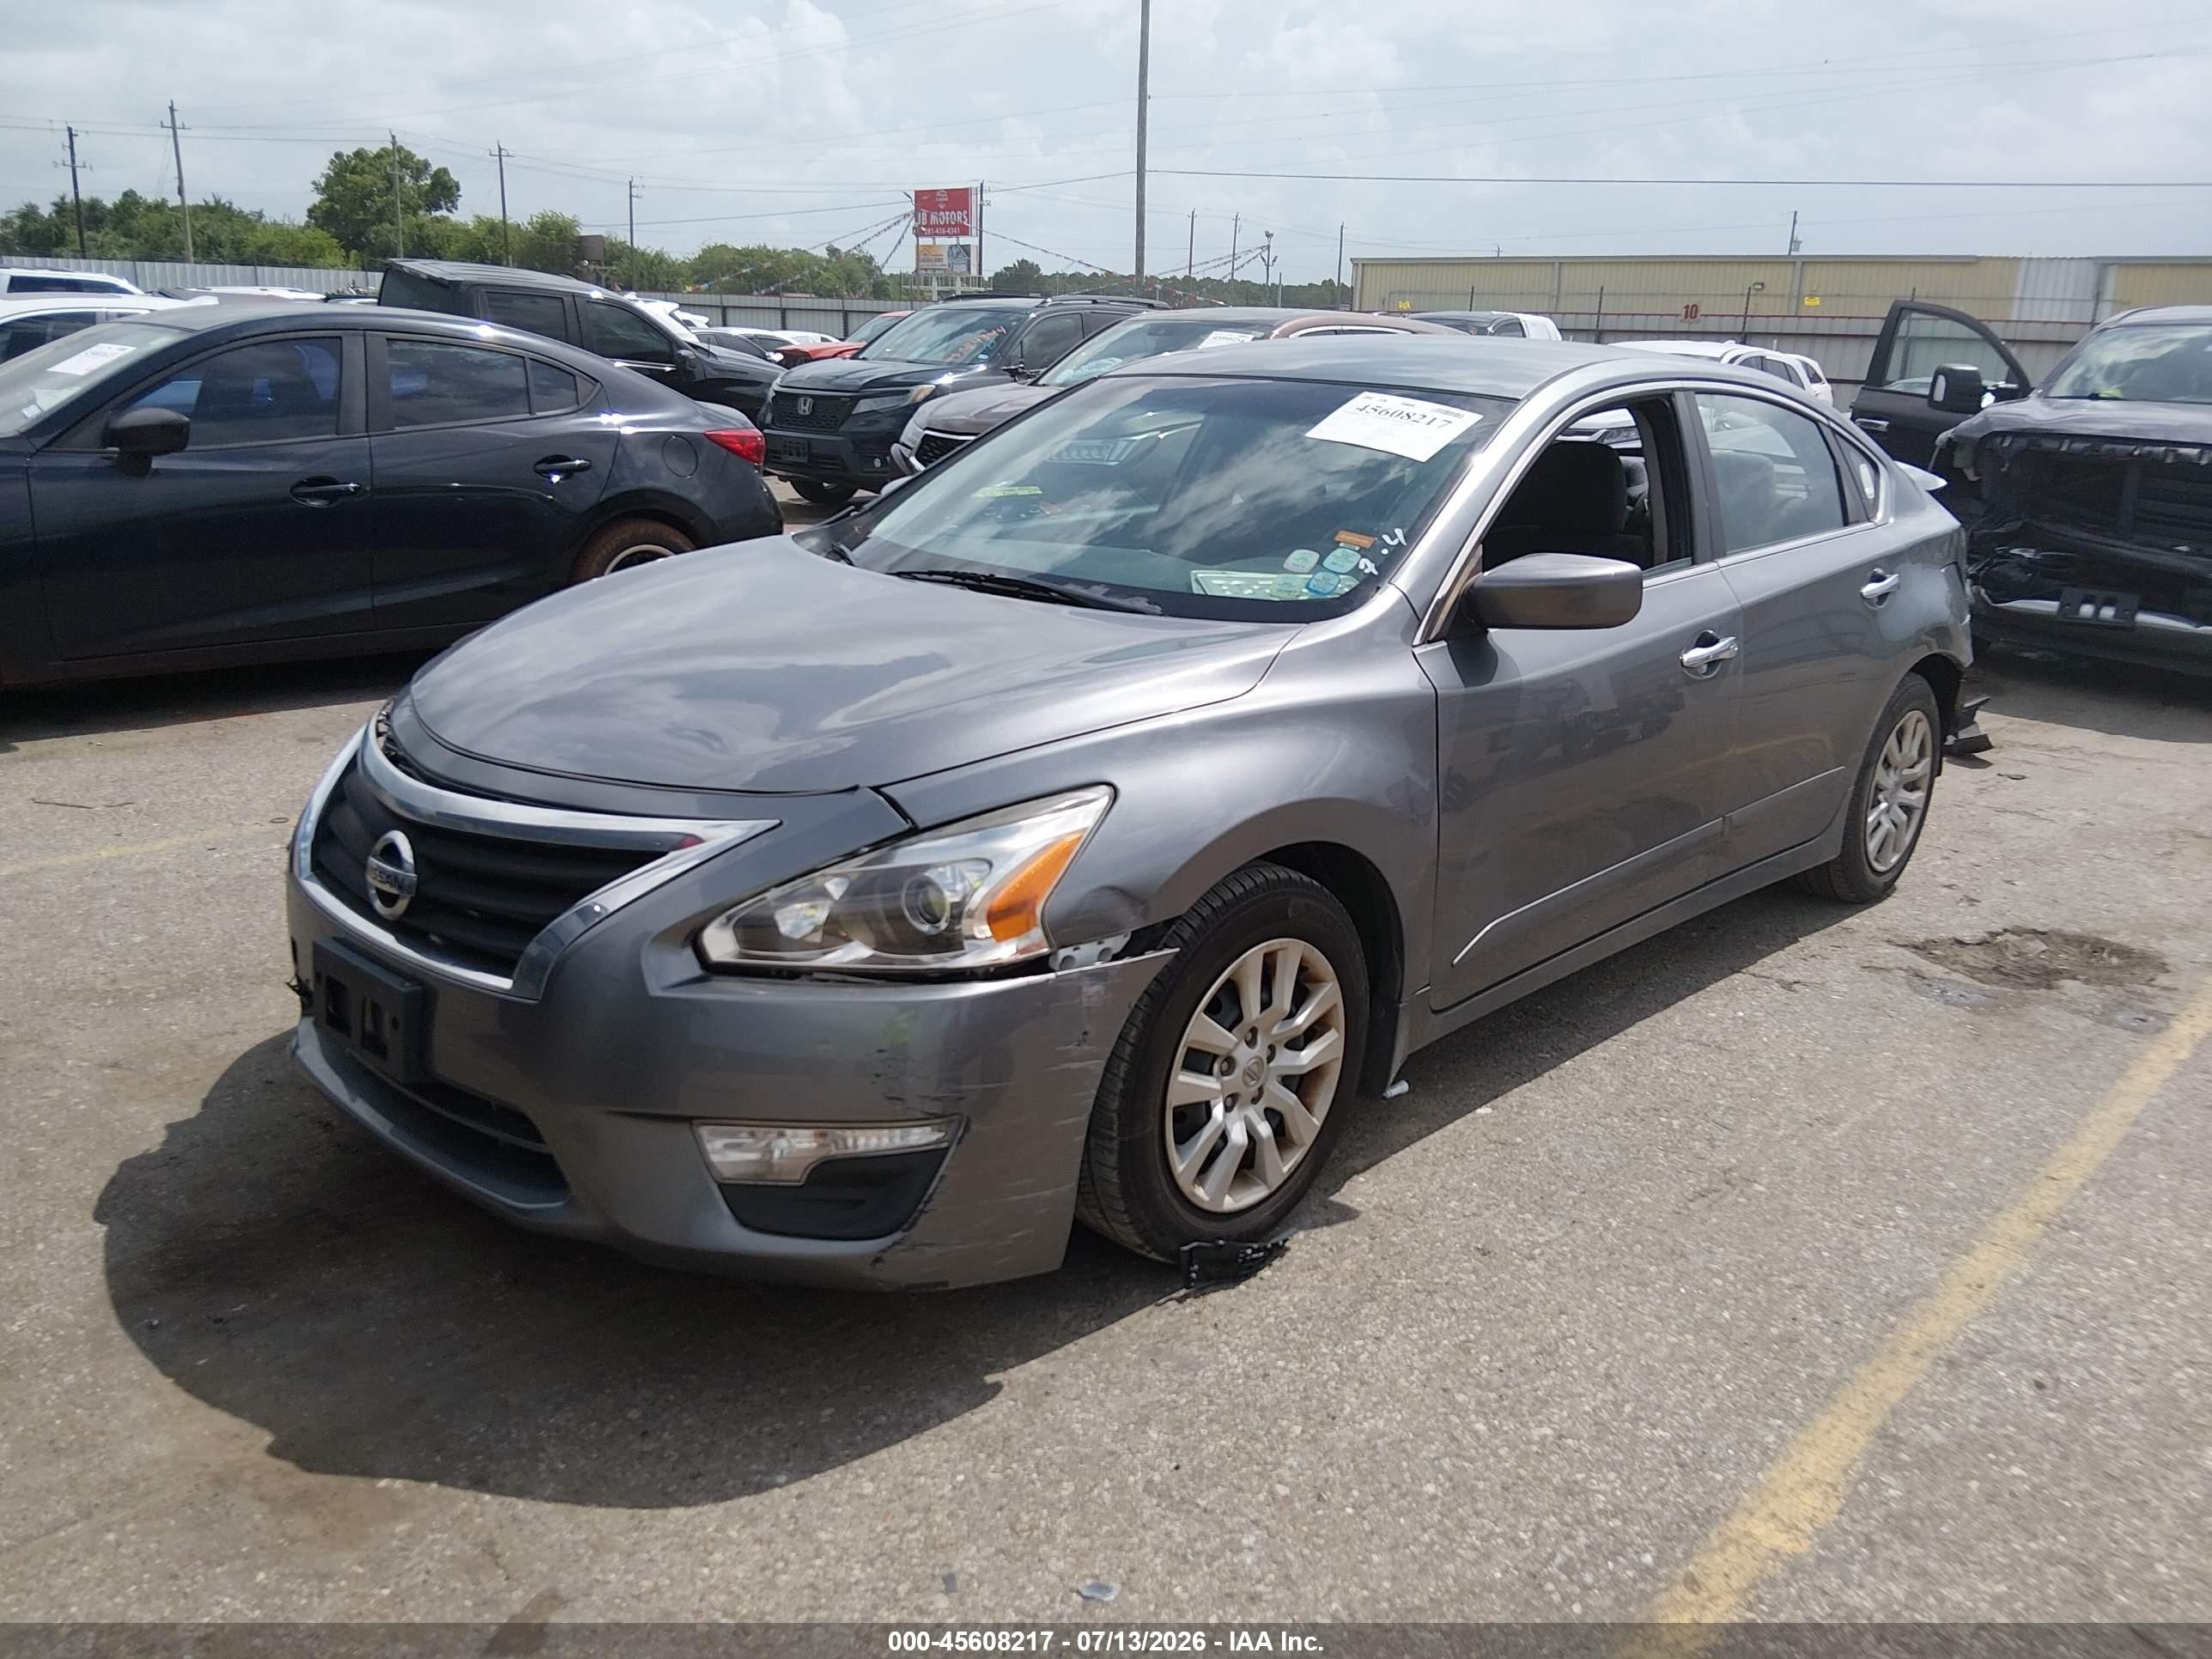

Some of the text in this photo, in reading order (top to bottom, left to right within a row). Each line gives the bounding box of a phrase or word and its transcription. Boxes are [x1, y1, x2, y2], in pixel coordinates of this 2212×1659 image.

[916, 210, 968, 226] JB MOTORS
[1683, 304, 1698, 319] 10
[1356, 404, 1453, 429] 45608217
[369, 866, 406, 891] SSAN
